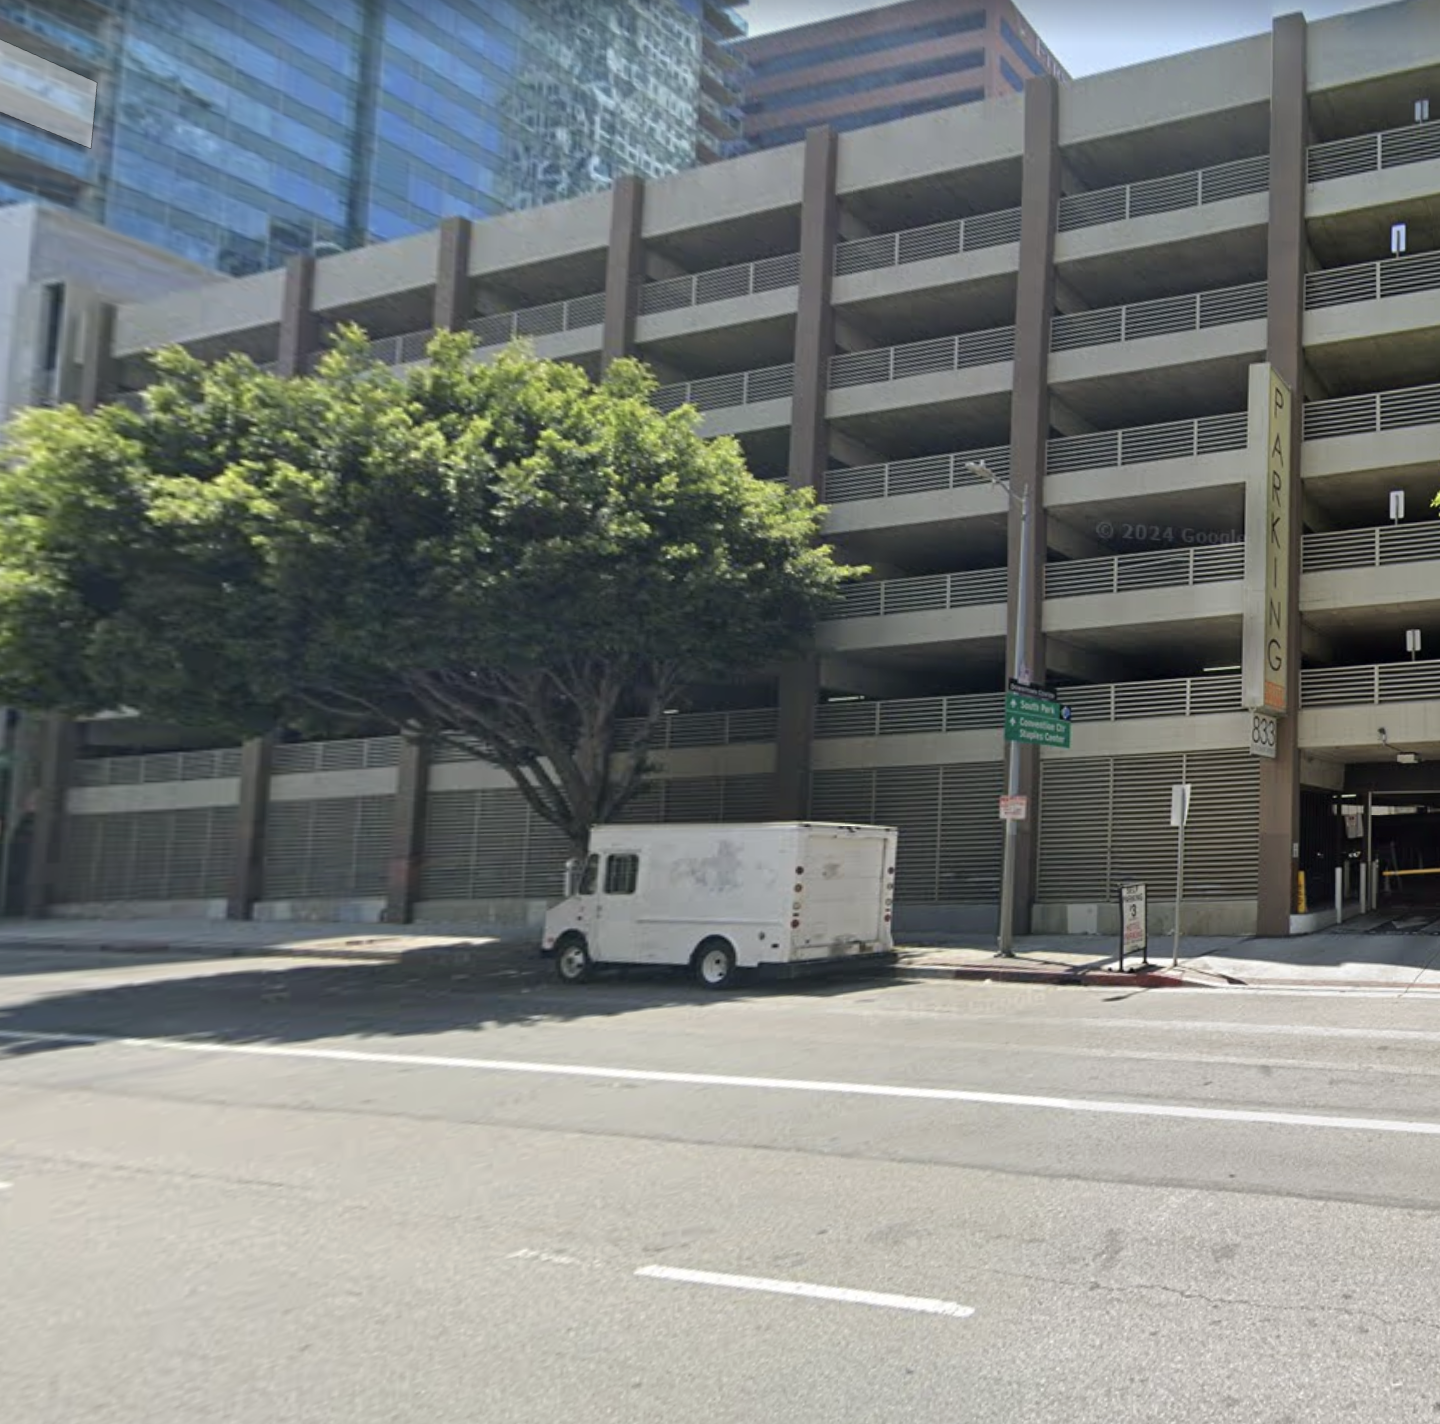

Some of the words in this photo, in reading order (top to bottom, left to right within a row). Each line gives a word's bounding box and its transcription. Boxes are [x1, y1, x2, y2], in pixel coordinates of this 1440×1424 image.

[1267, 388, 1285, 672] PARKING
[1020, 700, 1039, 711] South
[1041, 704, 1055, 714] Park
[1020, 717, 1055, 730] Convention
[1252, 715, 1276, 747] 833
[1020, 729, 1044, 742] Staples
[1044, 732, 1066, 744] Center
